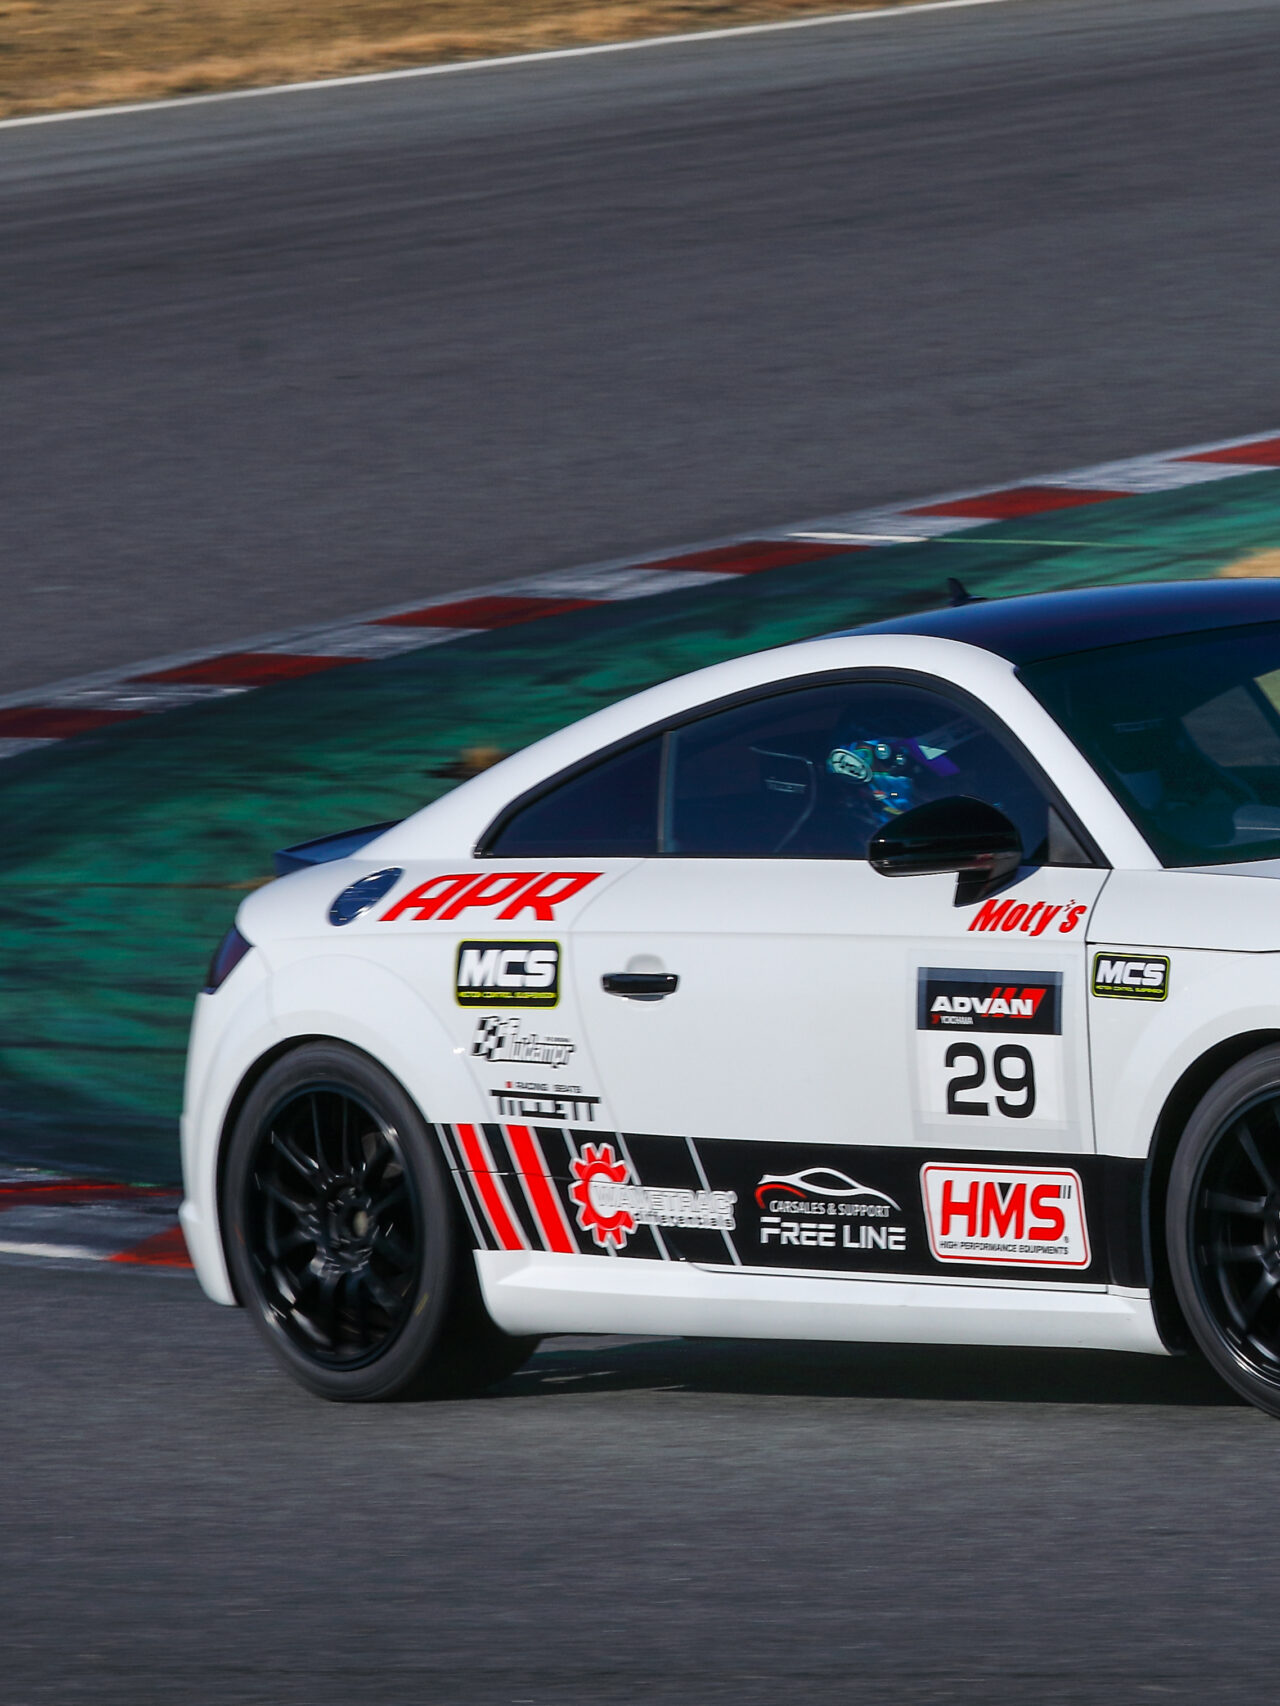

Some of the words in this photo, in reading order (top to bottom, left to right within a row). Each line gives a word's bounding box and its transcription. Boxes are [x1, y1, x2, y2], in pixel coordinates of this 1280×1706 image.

[377, 871, 605, 922] APR
[967, 899, 1087, 937] Moty's
[457, 949, 558, 987] MCS
[1096, 960, 1165, 986] MCS
[930, 996, 1034, 1015] ADVAN
[944, 1041, 1036, 1119] 29
[490, 1089, 601, 1121] TILLETT
[769, 1200, 826, 1215] CARSALES
[827, 1202, 837, 1216] &
[838, 1203, 891, 1218] SUPPORT
[940, 1180, 1068, 1241] HMS
[760, 1216, 836, 1247] FREE
[843, 1224, 906, 1251] LINE
[940, 1241, 958, 1249] HIGH
[960, 1241, 1017, 1253] PERFORMANCE
[1019, 1244, 1069, 1255] EQUIPMENTS
